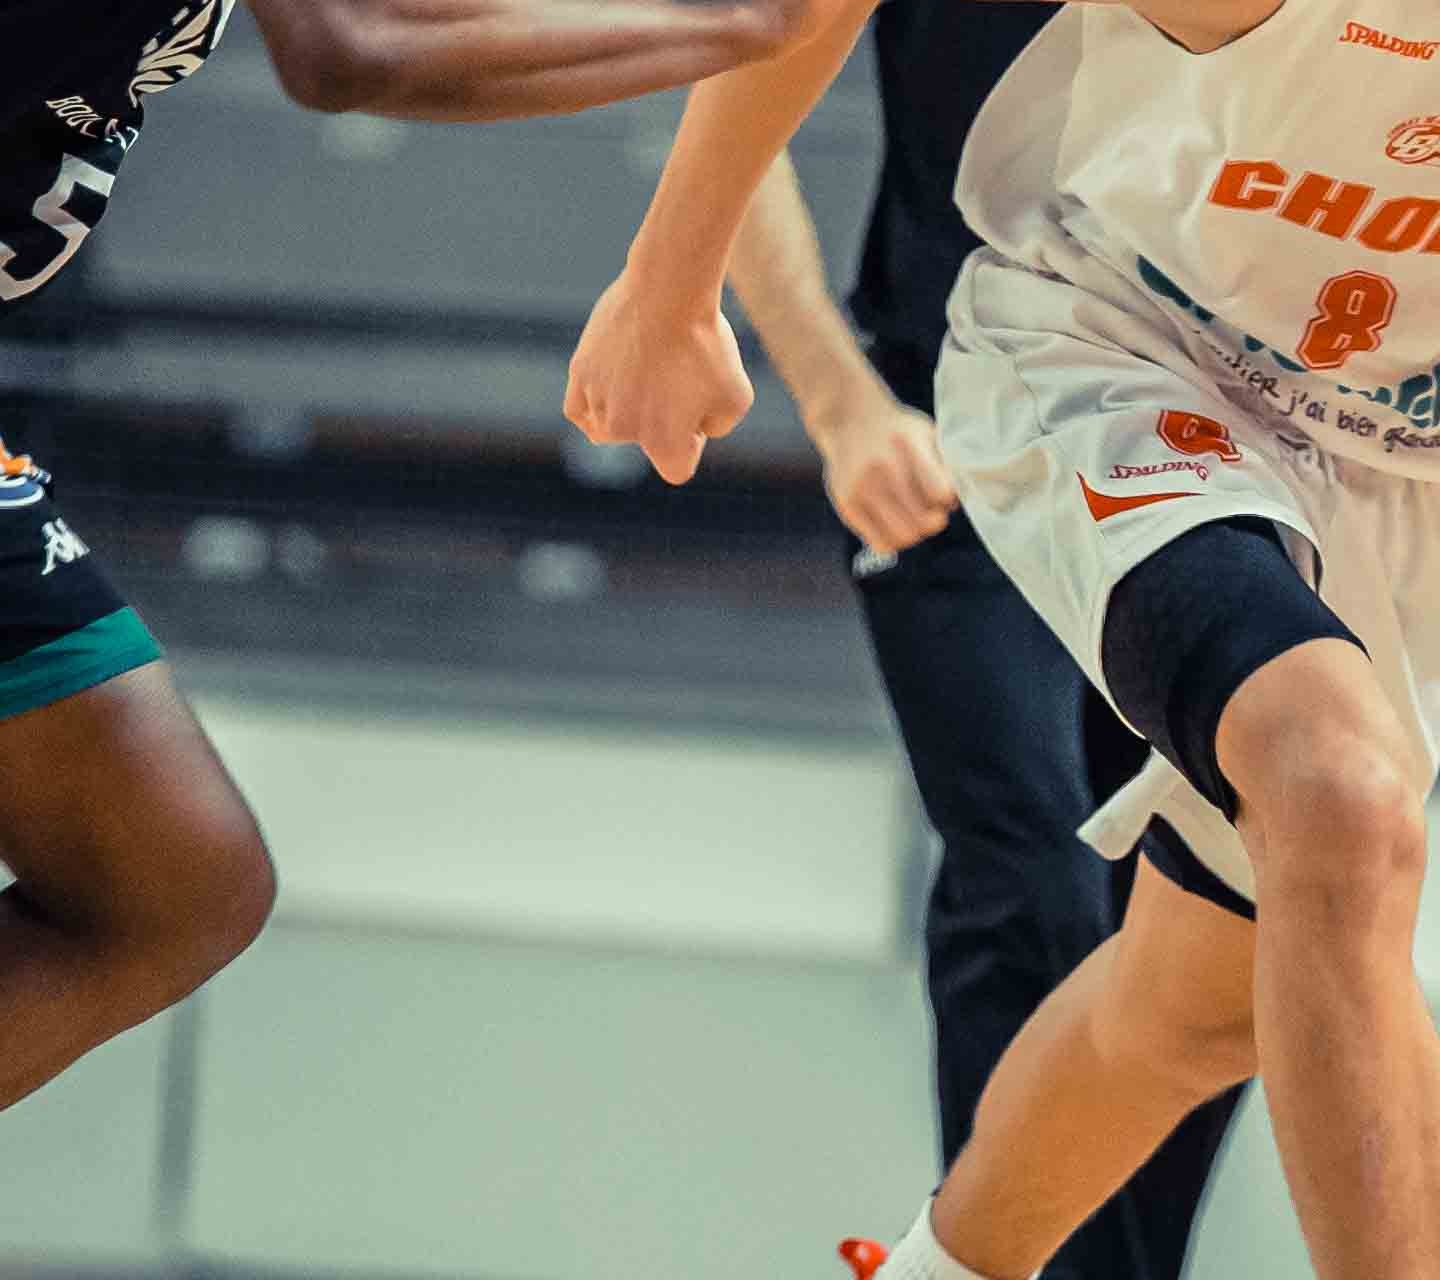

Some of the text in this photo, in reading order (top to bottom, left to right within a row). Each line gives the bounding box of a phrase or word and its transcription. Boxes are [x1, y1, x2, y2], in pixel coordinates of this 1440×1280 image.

[1338, 21, 1440, 61] SPALDING
[1294, 270, 1398, 371] 8
[1109, 460, 1210, 482] SPALDING
